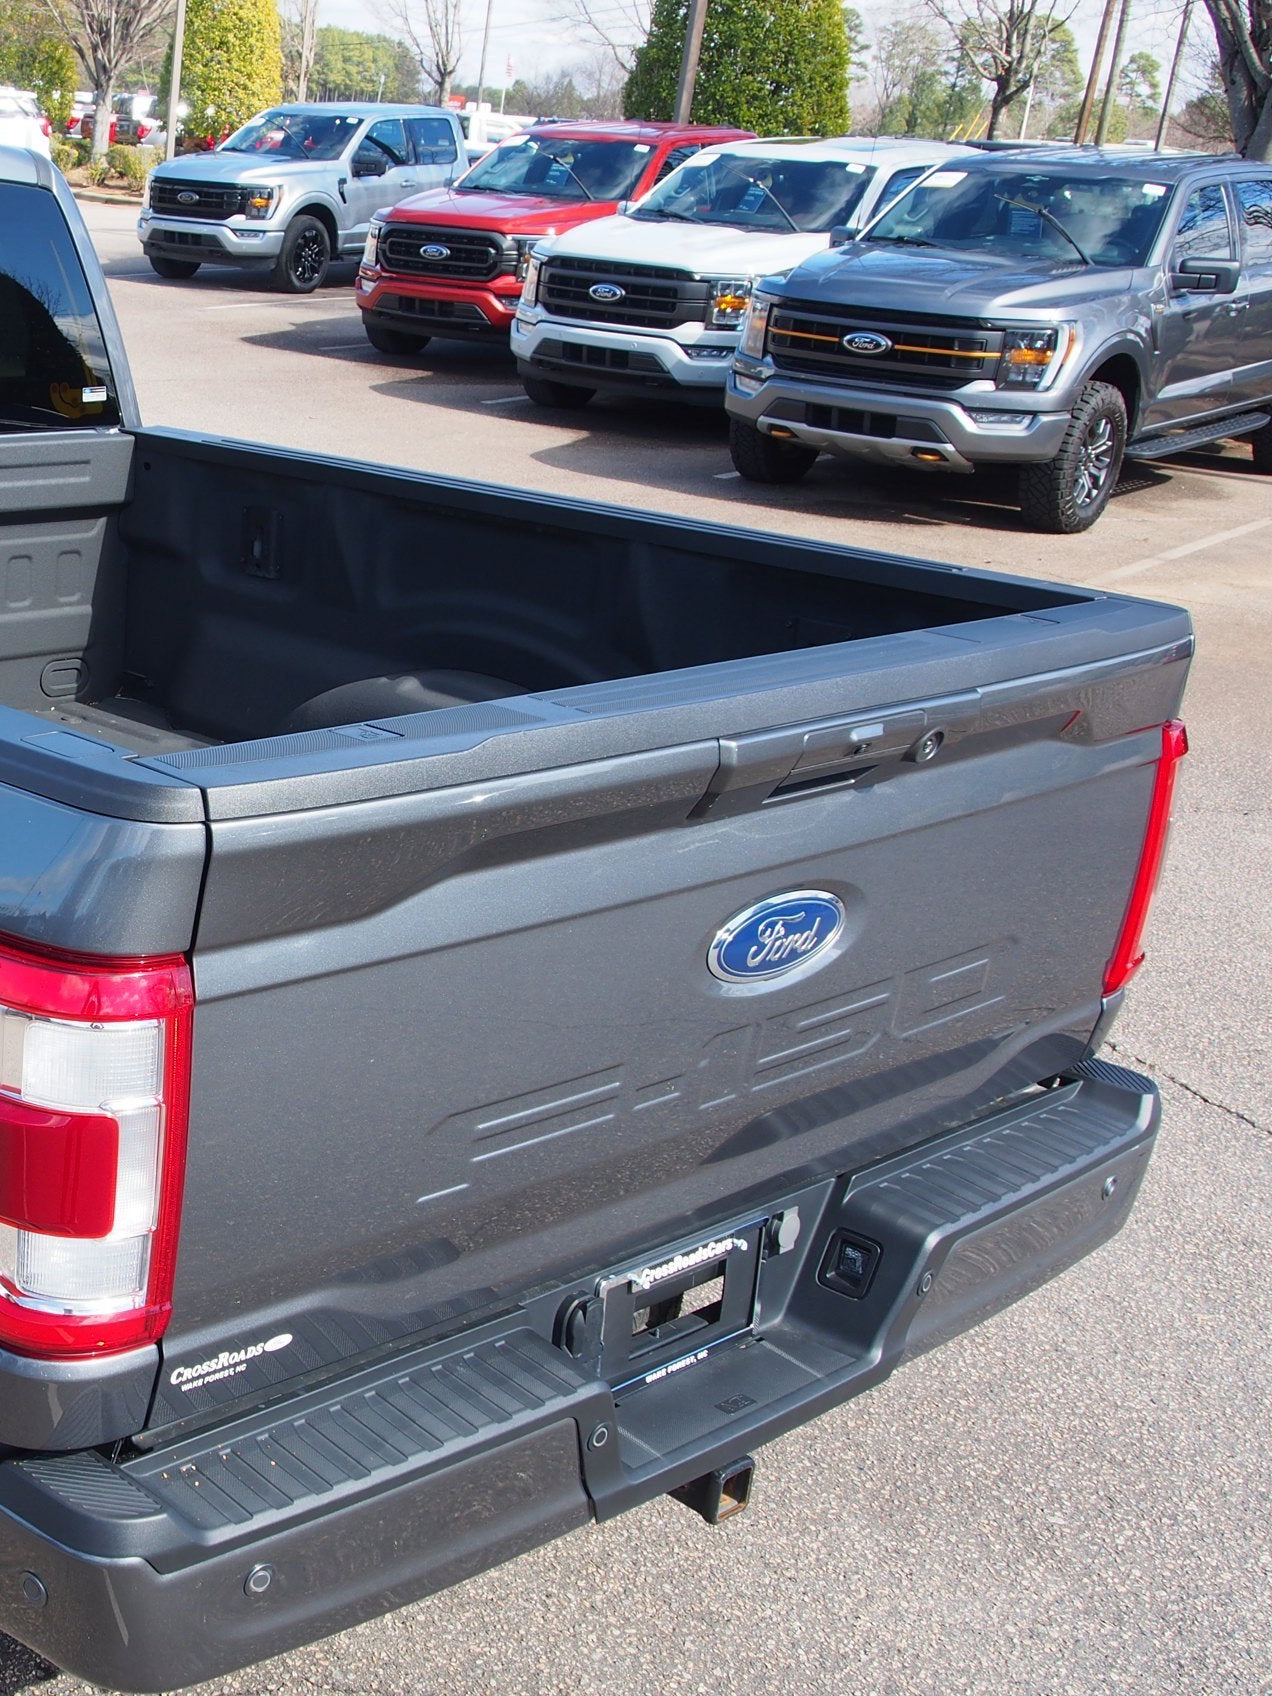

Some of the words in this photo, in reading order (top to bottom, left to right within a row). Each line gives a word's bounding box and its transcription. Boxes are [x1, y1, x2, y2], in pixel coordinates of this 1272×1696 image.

[851, 336, 876, 350] Ford
[746, 911, 822, 968] Ford
[416, 934, 1020, 1204] F-150
[181, 1379, 204, 1392] WAKE
[235, 1363, 248, 1374] NC
